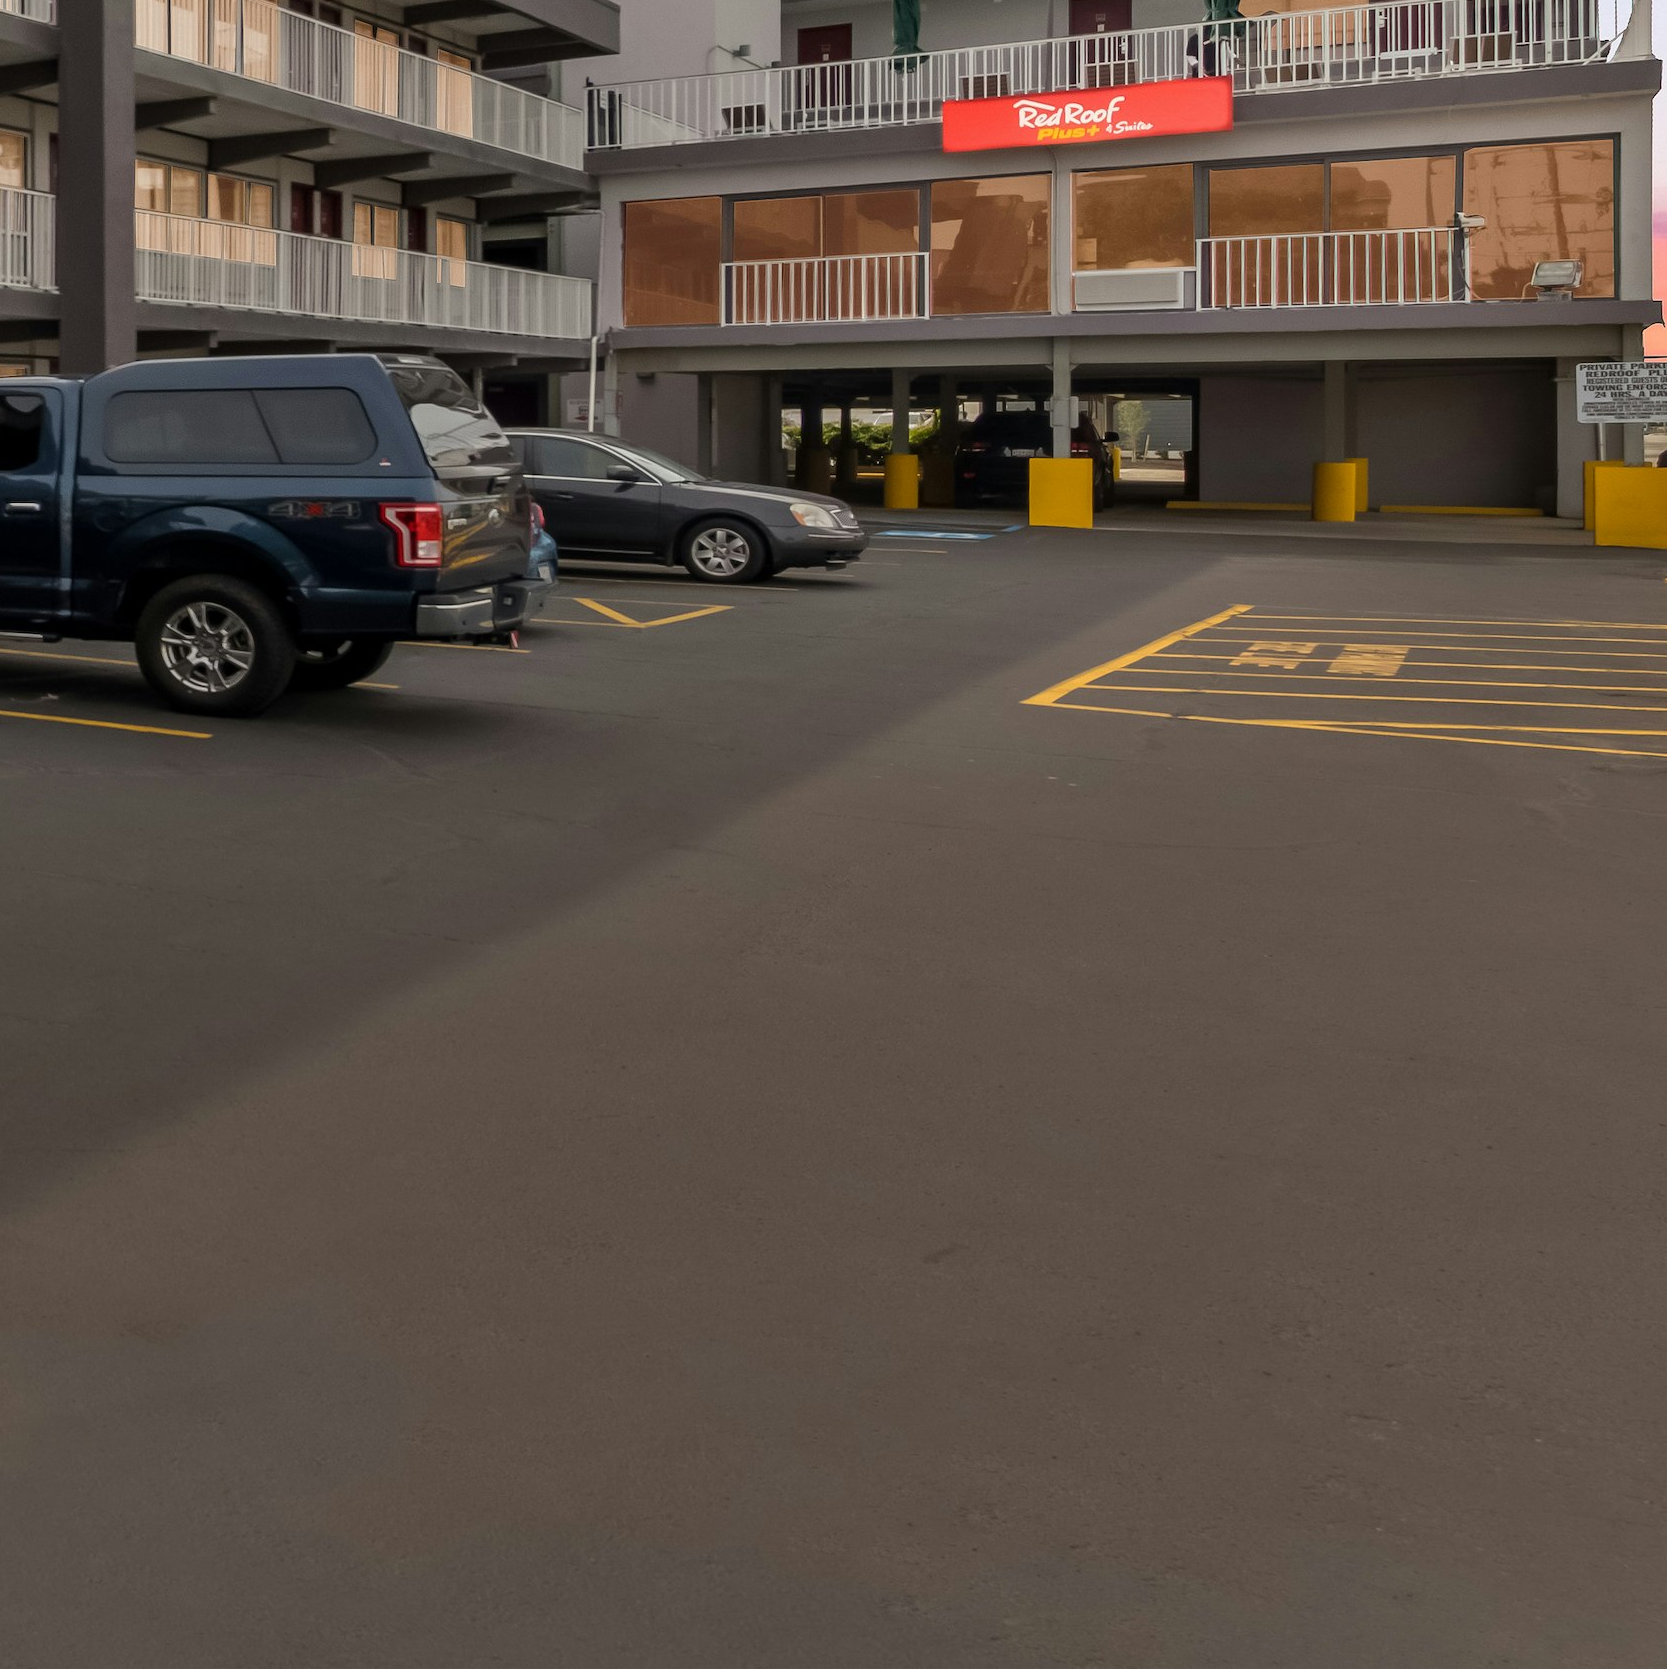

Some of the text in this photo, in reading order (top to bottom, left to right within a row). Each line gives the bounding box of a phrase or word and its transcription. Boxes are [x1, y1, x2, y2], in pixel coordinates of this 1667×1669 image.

[1113, 121, 1154, 134] Suites
[1579, 363, 1626, 371] PRIVATE
[1586, 377, 1629, 385] REGISTERED
[1594, 391, 1606, 399] 24
